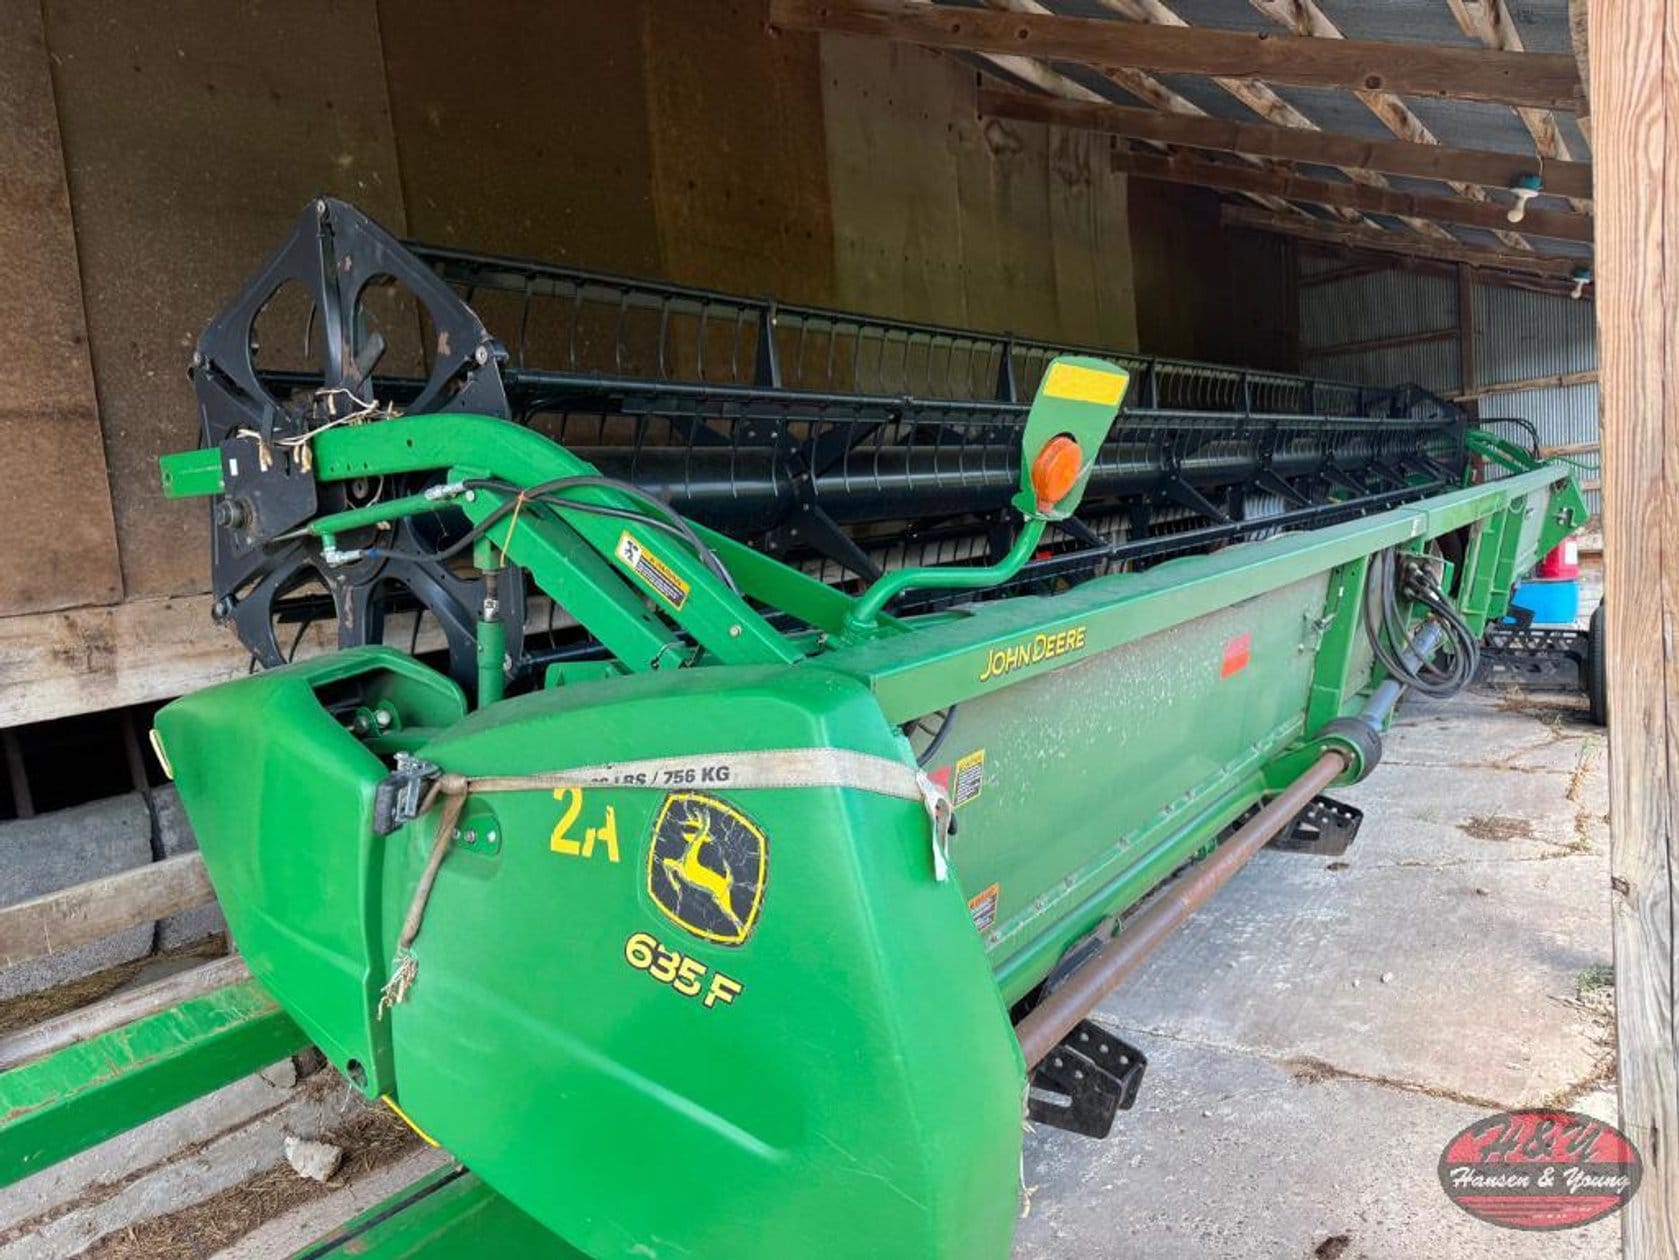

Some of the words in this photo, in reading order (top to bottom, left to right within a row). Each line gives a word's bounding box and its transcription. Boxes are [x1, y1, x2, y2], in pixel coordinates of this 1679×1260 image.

[978, 644, 1032, 682] JOHN
[1032, 626, 1086, 663] DEERE
[663, 768, 696, 785] 756
[701, 765, 730, 783] KG
[550, 786, 620, 863] 2A
